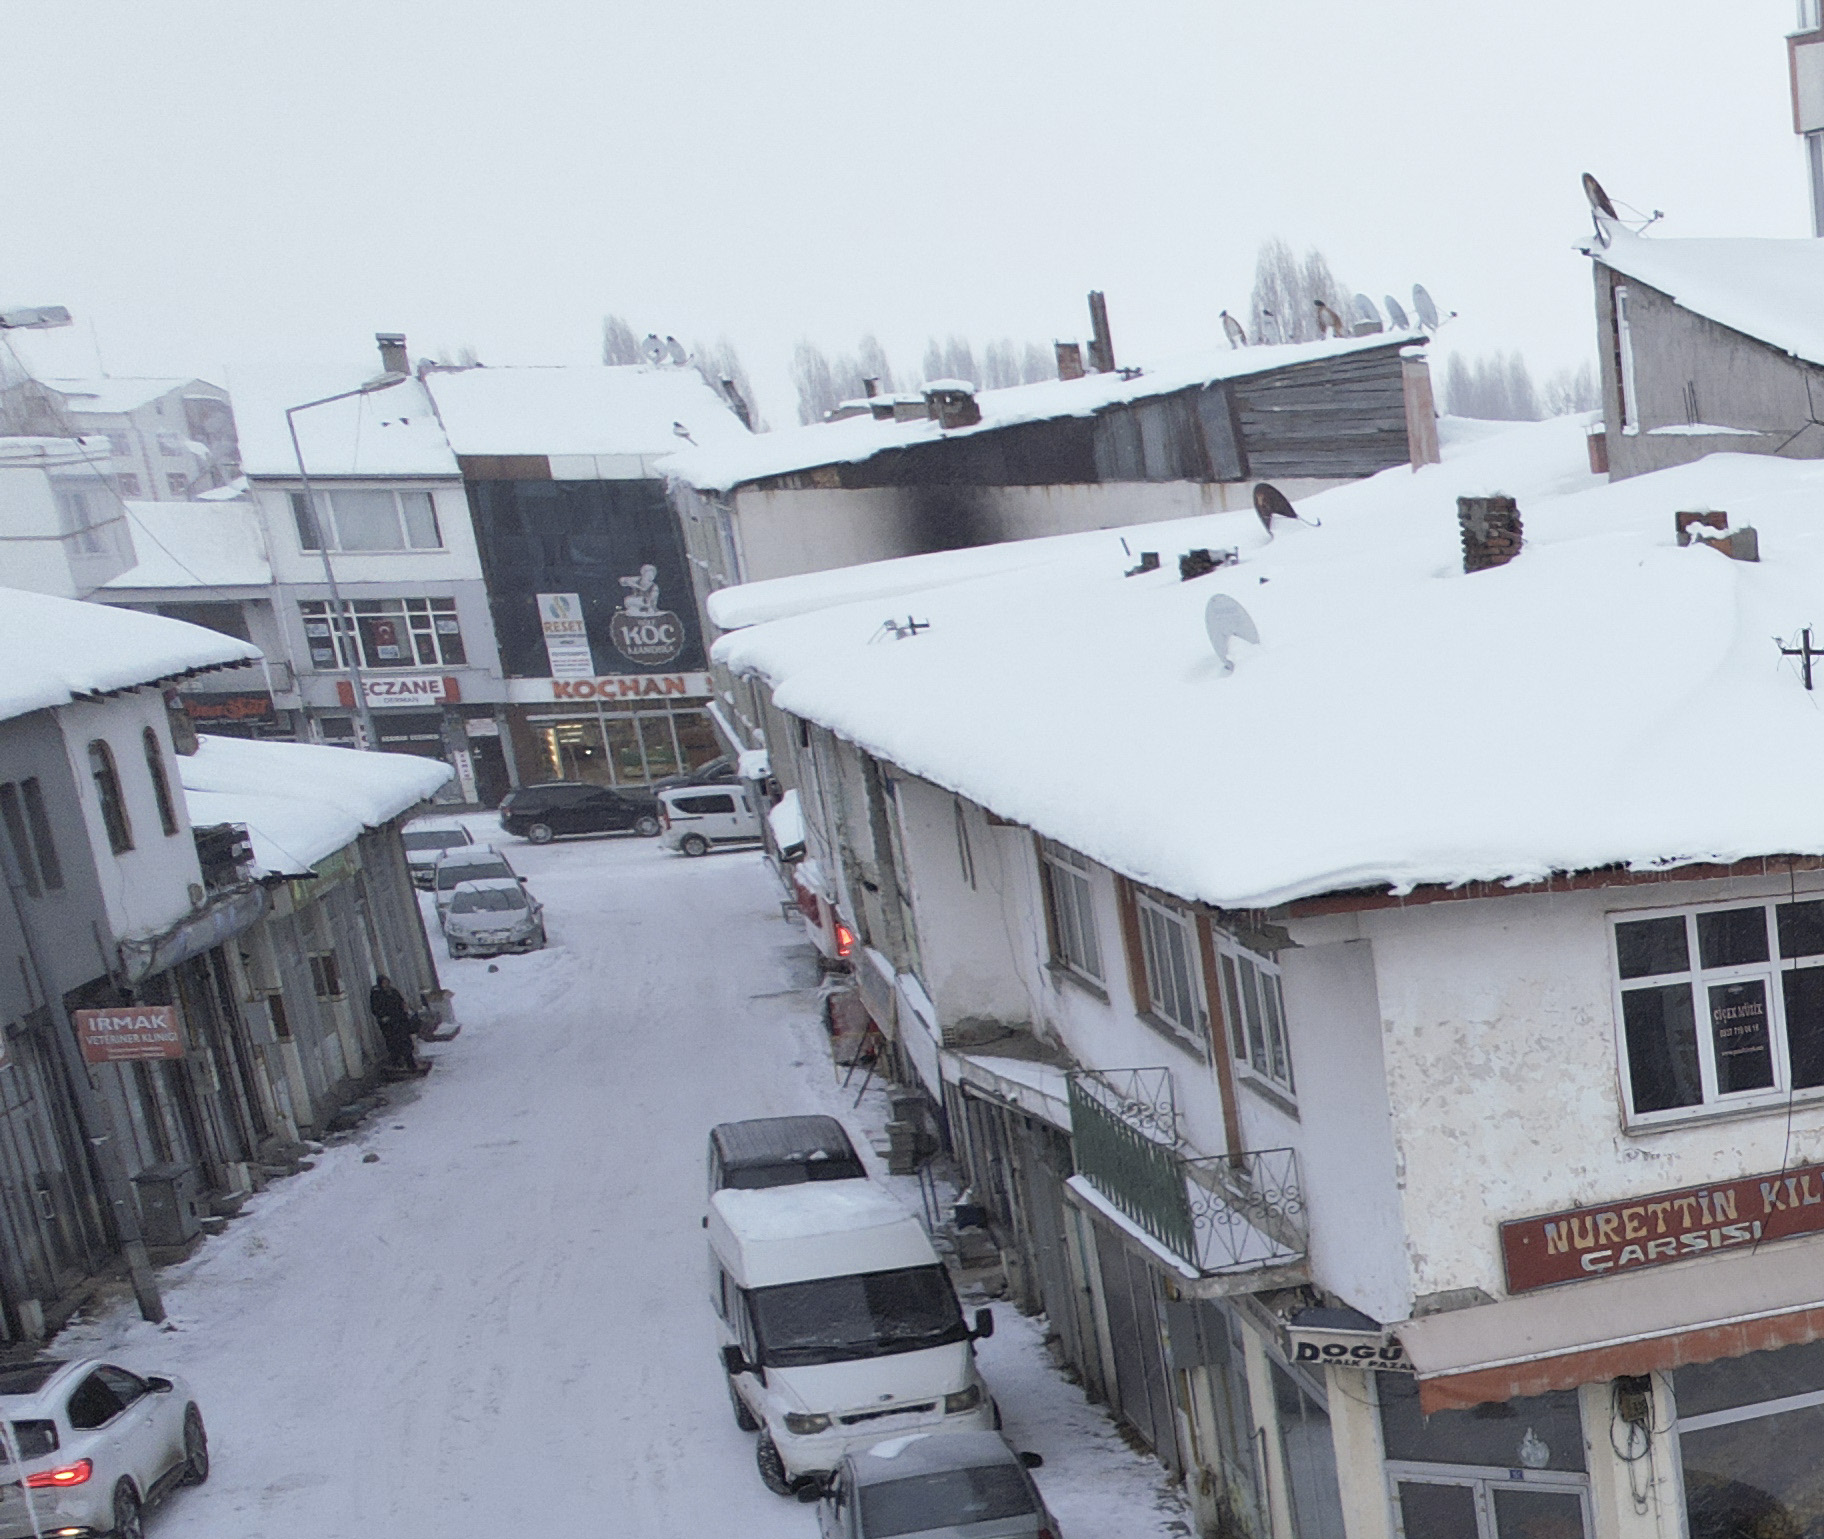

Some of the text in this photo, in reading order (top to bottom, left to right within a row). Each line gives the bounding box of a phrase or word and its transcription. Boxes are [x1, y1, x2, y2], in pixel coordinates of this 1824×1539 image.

[543, 621, 583, 633] RESET
[620, 624, 677, 645] KOÇ
[553, 676, 687, 700] KOÇHAN
[87, 1014, 168, 1031] IRMAK
[1543, 1188, 1737, 1256] NURETTİN
